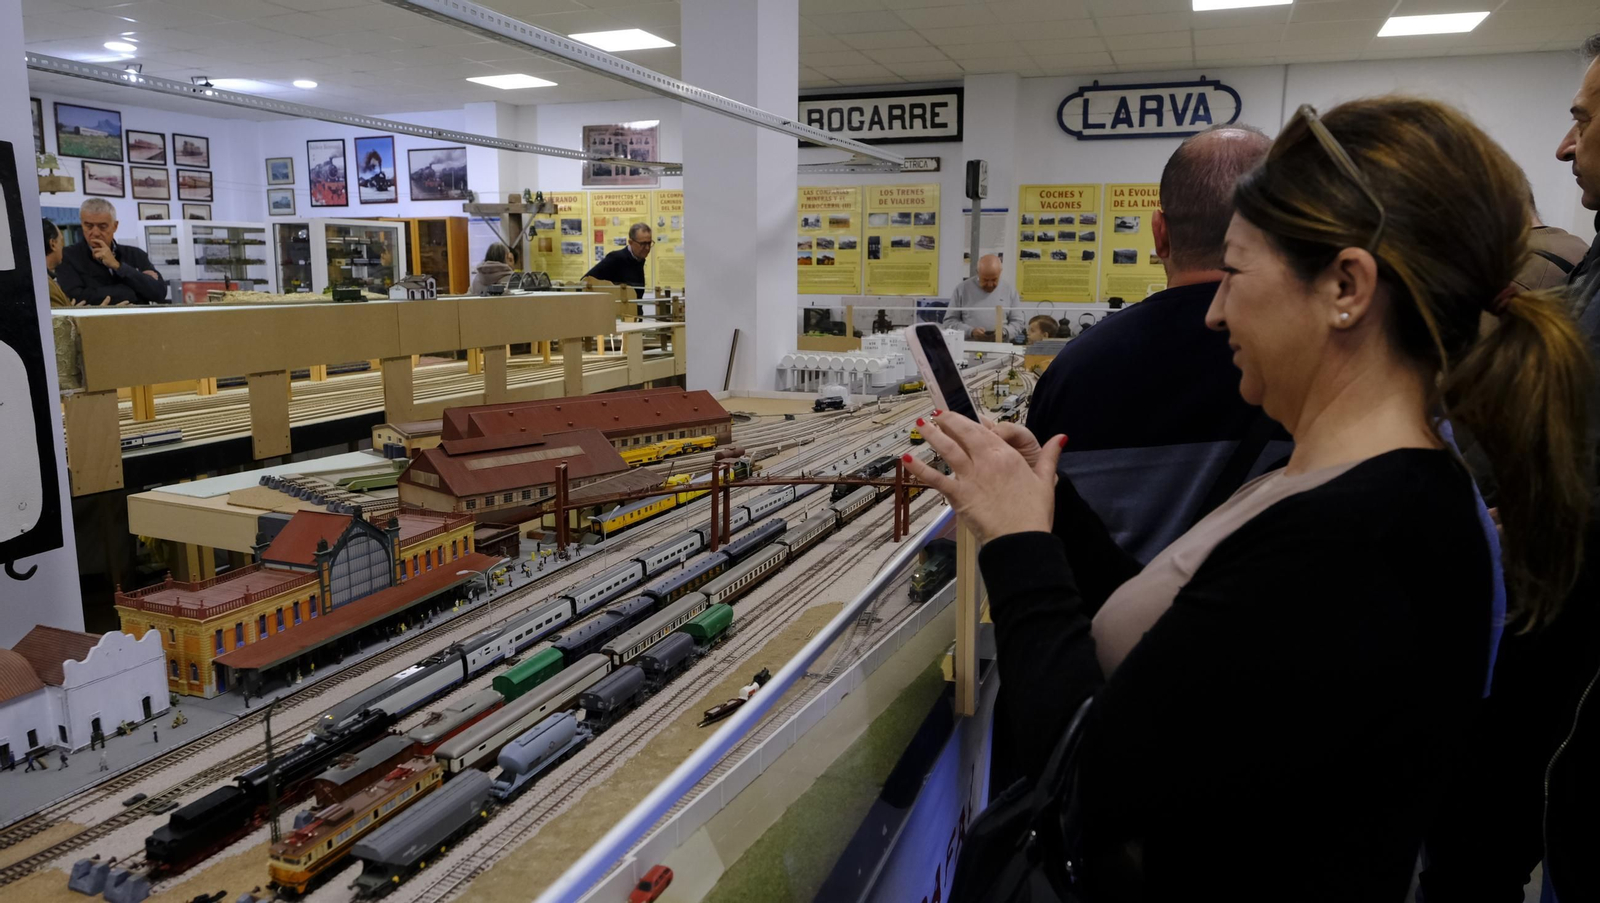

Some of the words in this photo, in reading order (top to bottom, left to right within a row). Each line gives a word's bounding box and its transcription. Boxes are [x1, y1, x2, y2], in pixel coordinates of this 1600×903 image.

[1083, 92, 1213, 129] LARVA
[880, 189, 894, 197] LOS
[896, 188, 925, 196] TRENES
[1039, 190, 1076, 198] COCHES
[1078, 190, 1084, 198] Y
[1114, 189, 1125, 197] LA
[1128, 188, 1158, 197] EVOLU
[544, 195, 578, 203] SPERANDO
[890, 197, 926, 205] VIAJEROS
[1113, 199, 1125, 208] DE
[1128, 199, 1139, 207] LA
[1040, 200, 1082, 209] VAGONES
